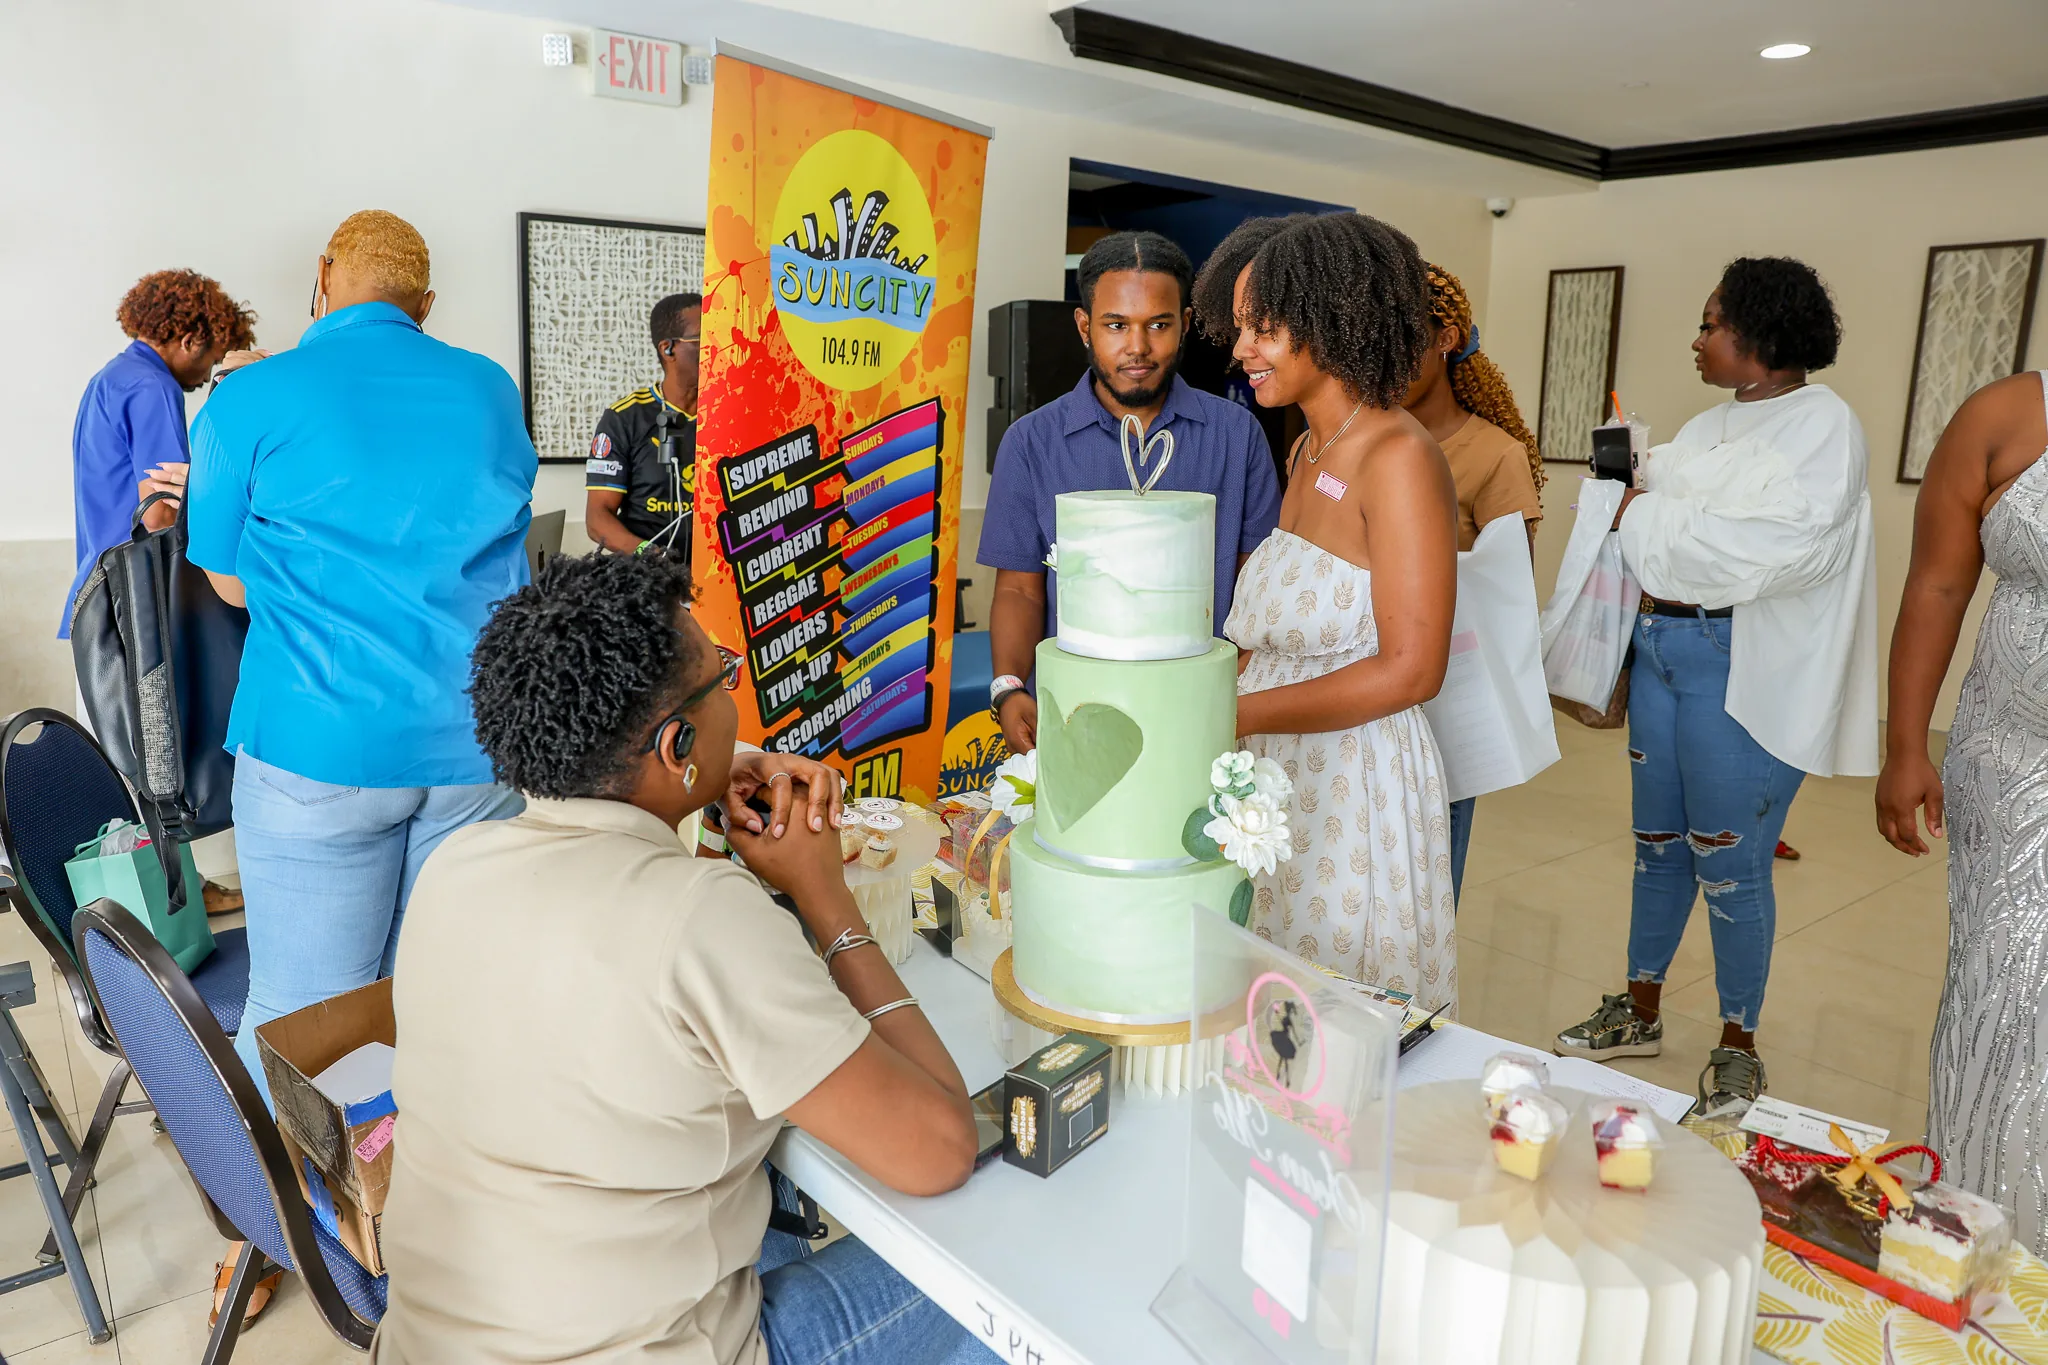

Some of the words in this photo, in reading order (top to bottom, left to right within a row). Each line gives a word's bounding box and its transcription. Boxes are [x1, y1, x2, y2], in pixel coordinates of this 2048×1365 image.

[609, 35, 671, 95] EXIT
[778, 262, 931, 318] SUNCITY
[822, 337, 859, 365] 104.9
[863, 340, 881, 367] FM
[729, 433, 813, 491] SUPREME
[844, 431, 884, 461] SUNDAYS
[738, 485, 809, 538] REWIND
[845, 475, 886, 507] MONDAYS
[746, 522, 823, 582] CURRENT
[847, 516, 889, 549] TUESDAYS
[844, 553, 899, 596] WEDNESDAYS
[753, 572, 818, 627] REGGAE
[850, 595, 898, 634] THURSDAYS
[760, 610, 828, 670] LOVERS
[858, 640, 891, 672] FRIDAYS
[766, 651, 832, 710] TUN-UP
[860, 681, 908, 720] SATURDAYS
[776, 676, 873, 755] SCORCHING
[1062, 1077, 1101, 1107] Chalkboard
[1074, 1076, 1090, 1092] Mini
[1019, 1100, 1027, 1153] Chalkboard
